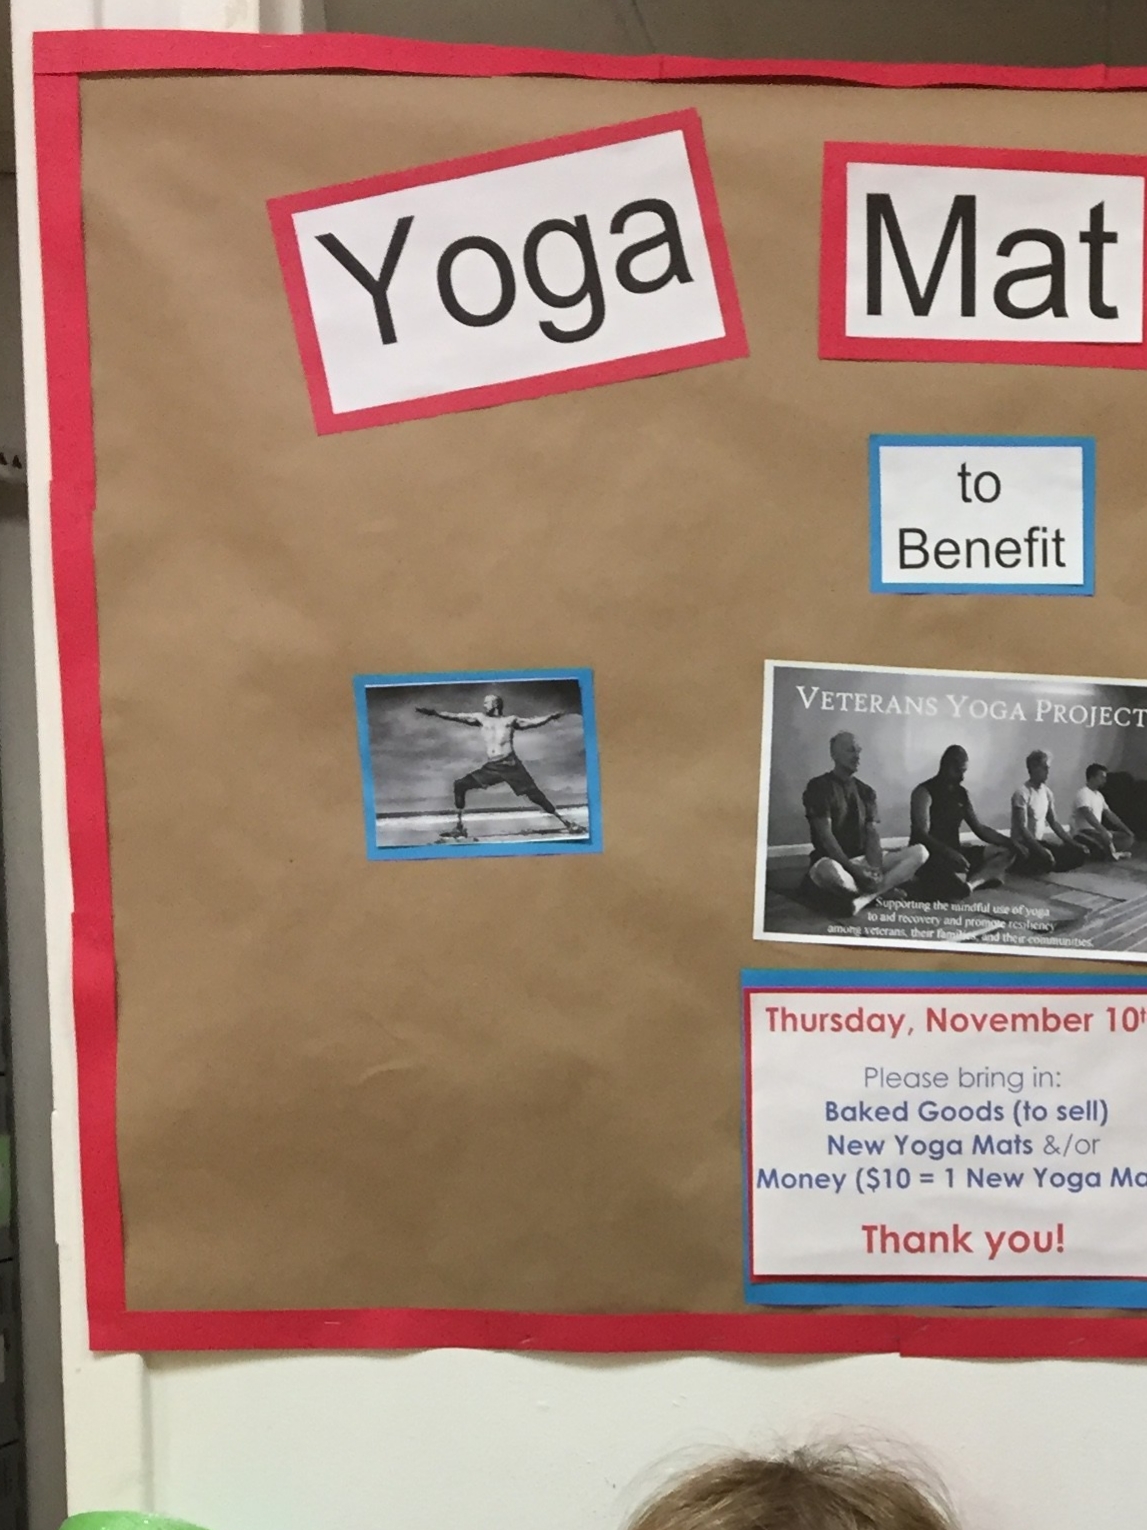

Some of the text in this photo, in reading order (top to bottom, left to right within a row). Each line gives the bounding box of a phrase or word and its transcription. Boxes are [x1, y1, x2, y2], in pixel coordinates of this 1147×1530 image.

[315, 196, 694, 345] Yoga
[864, 193, 1118, 319] Mat
[958, 462, 1001, 503] to
[899, 526, 1066, 570] Benefit
[796, 686, 938, 715] VETERANS
[946, 694, 1026, 721] YOGA
[868, 912, 877, 921] to
[880, 912, 894, 922] aid
[898, 915, 940, 926] recovery
[944, 915, 962, 926] and
[876, 897, 1050, 918] Supporting the mindful use of yoga
[911, 928, 933, 938] their
[982, 931, 1000, 942] and
[1002, 933, 1026, 943] their
[766, 1007, 914, 1038] Thursday,
[926, 1008, 1094, 1032] November
[864, 1067, 1061, 1093] Please bring in:
[825, 1099, 1108, 1126] Baked Goods (to sell)
[827, 1134, 1101, 1159] New Yoga Mats &/or
[756, 1169, 846, 1193] Money
[856, 1167, 911, 1193] ($10
[946, 1167, 953, 1187] 1
[967, 1167, 1024, 1188] New
[1034, 1167, 1101, 1192] Yoga
[862, 1224, 1065, 1259] Thank you!
